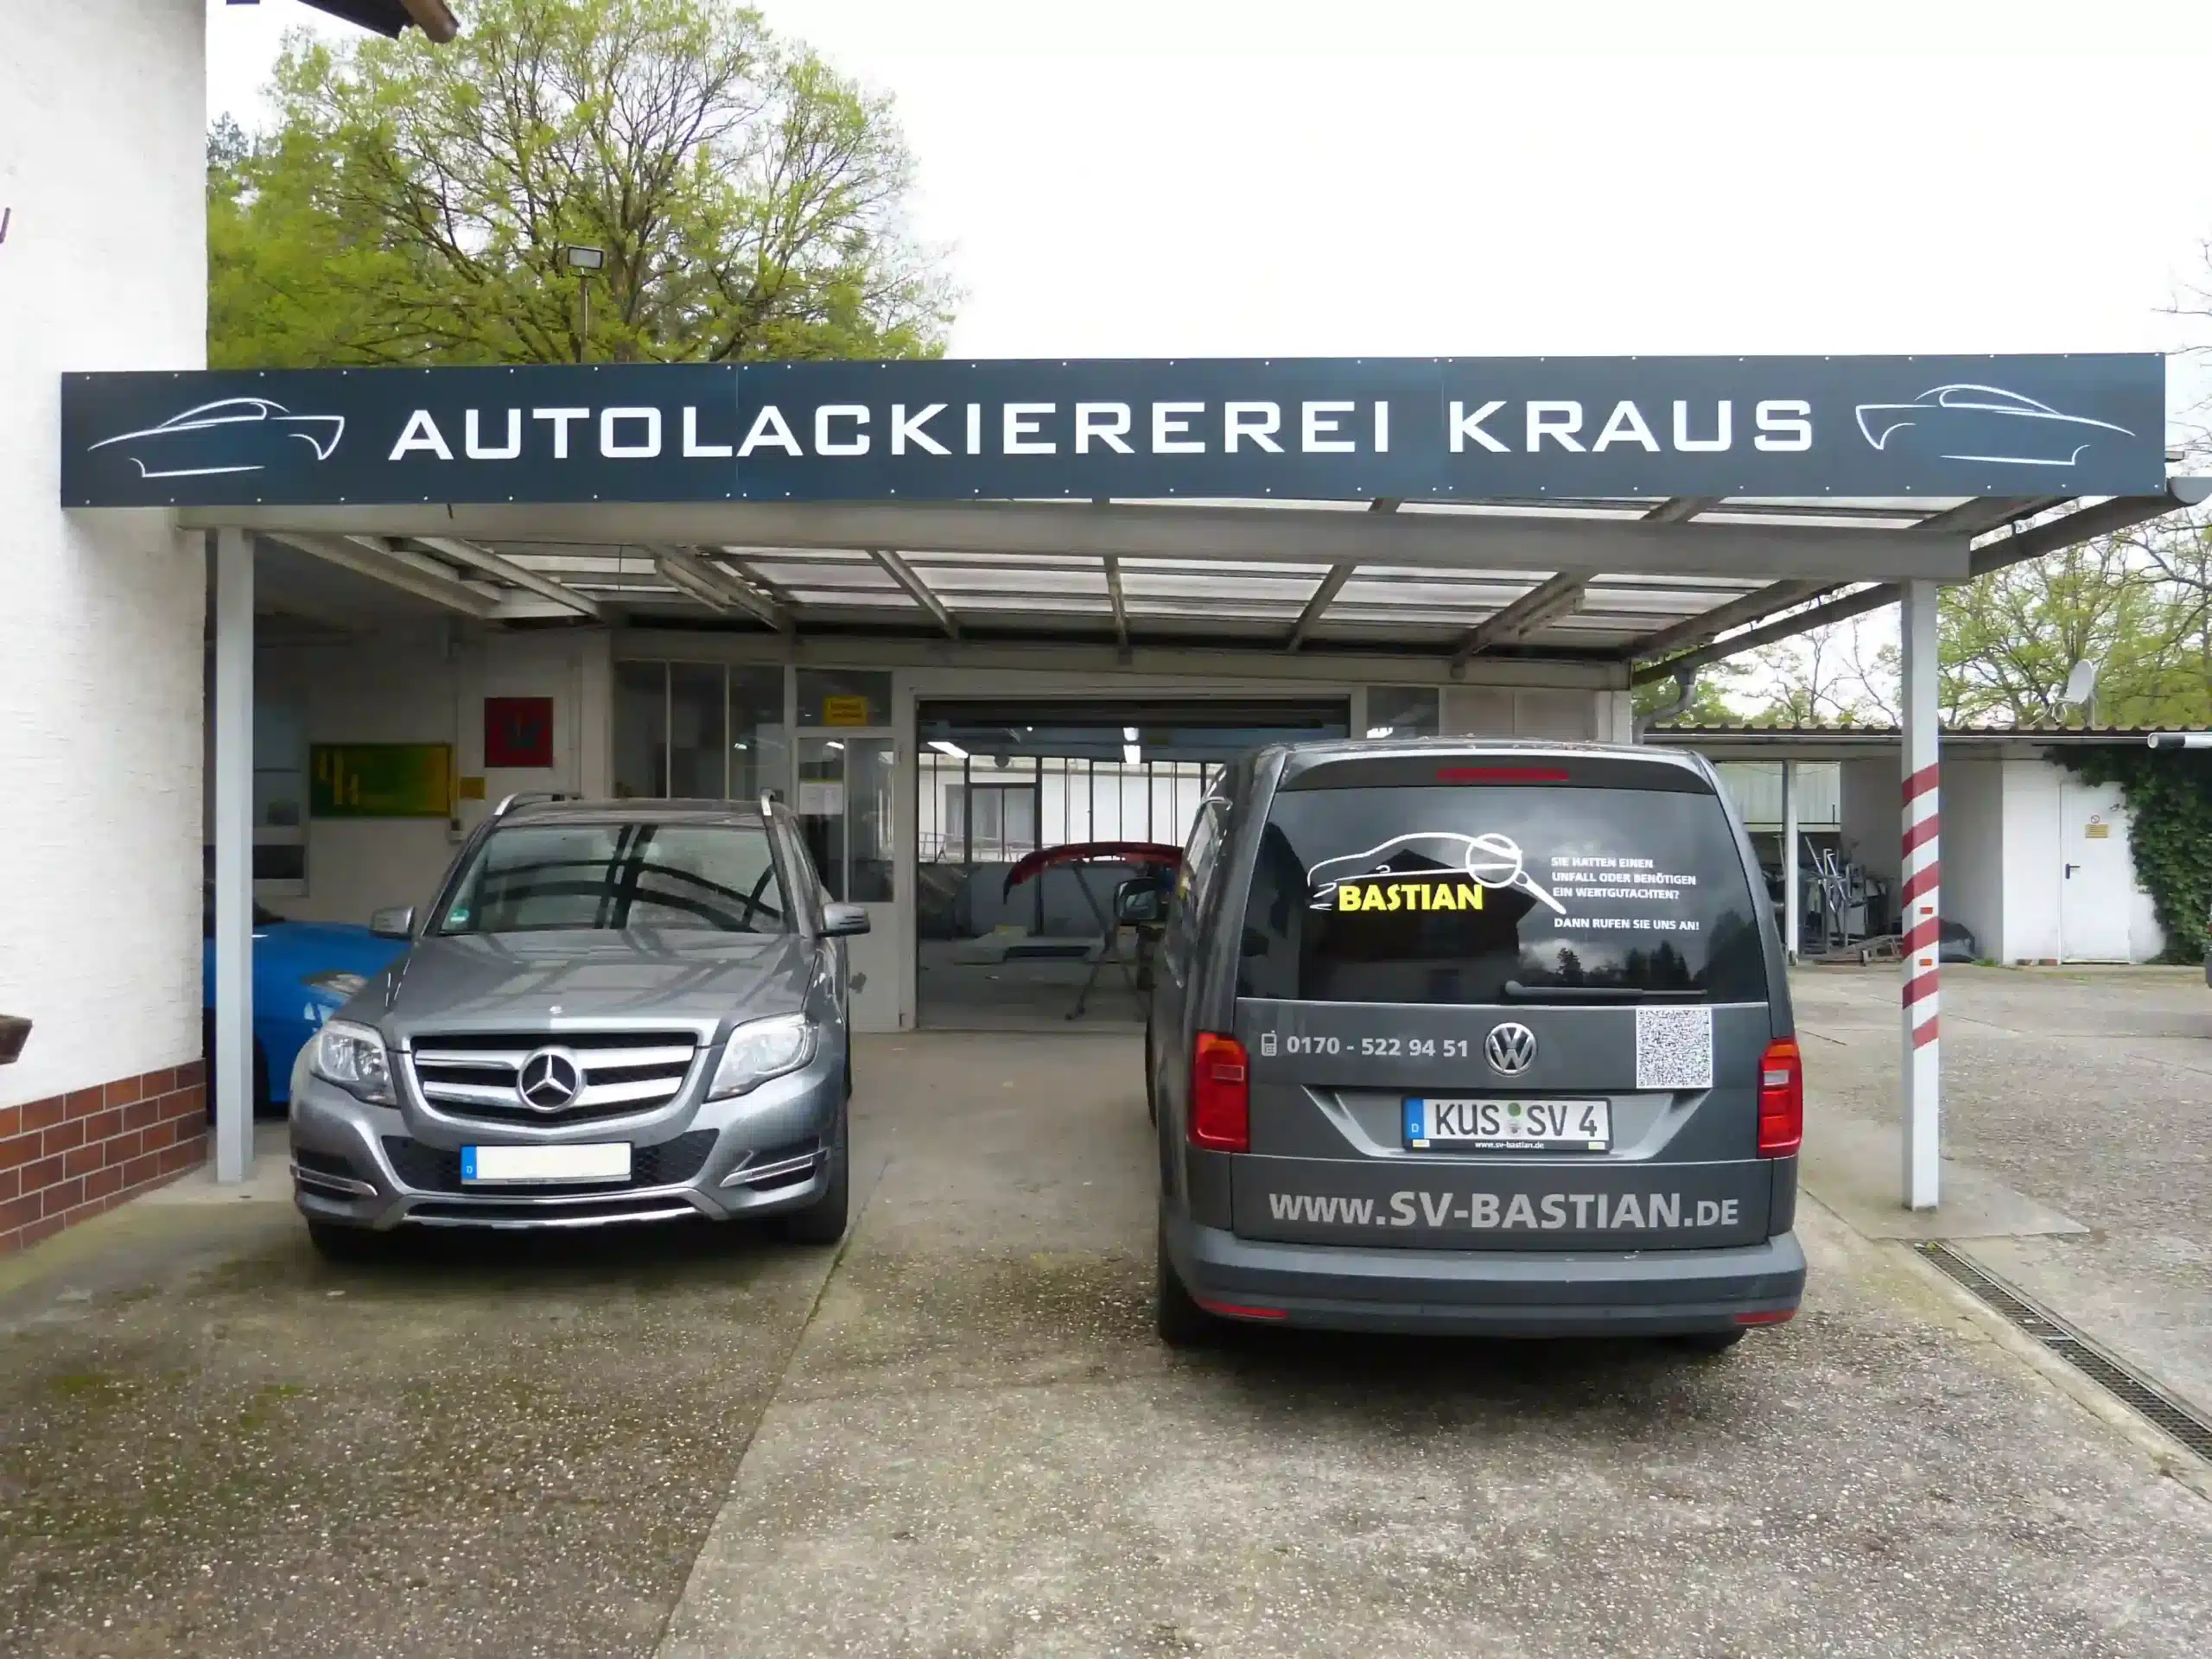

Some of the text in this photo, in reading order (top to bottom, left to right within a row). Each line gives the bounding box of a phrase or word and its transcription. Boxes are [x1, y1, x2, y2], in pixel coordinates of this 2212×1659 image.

[388, 400, 1812, 461] AUTOLACKIEREREI KRAUS
[1551, 857, 1654, 868] SIE HATTEN EINEN
[1552, 872, 1696, 885] UNFALL ODER BENÖTIGEN
[1338, 883, 1484, 912] BASTIAN
[1553, 887, 1680, 899] EIN WERTGUTACHTEN?
[1554, 918, 1700, 931] DANN RUFEN SIE UNS AN!
[1287, 1036, 1340, 1054] 0170
[1361, 1038, 1402, 1056] 522
[1408, 1039, 1436, 1057] 94
[1443, 1039, 1468, 1058] 51
[1434, 1103, 1599, 1137] KUS SV 4
[1411, 1123, 1420, 1133] D
[1475, 1141, 1546, 1149] www.sv-bastian.de
[1268, 1192, 1739, 1229] WWW.SV-BASTIAN.DE
